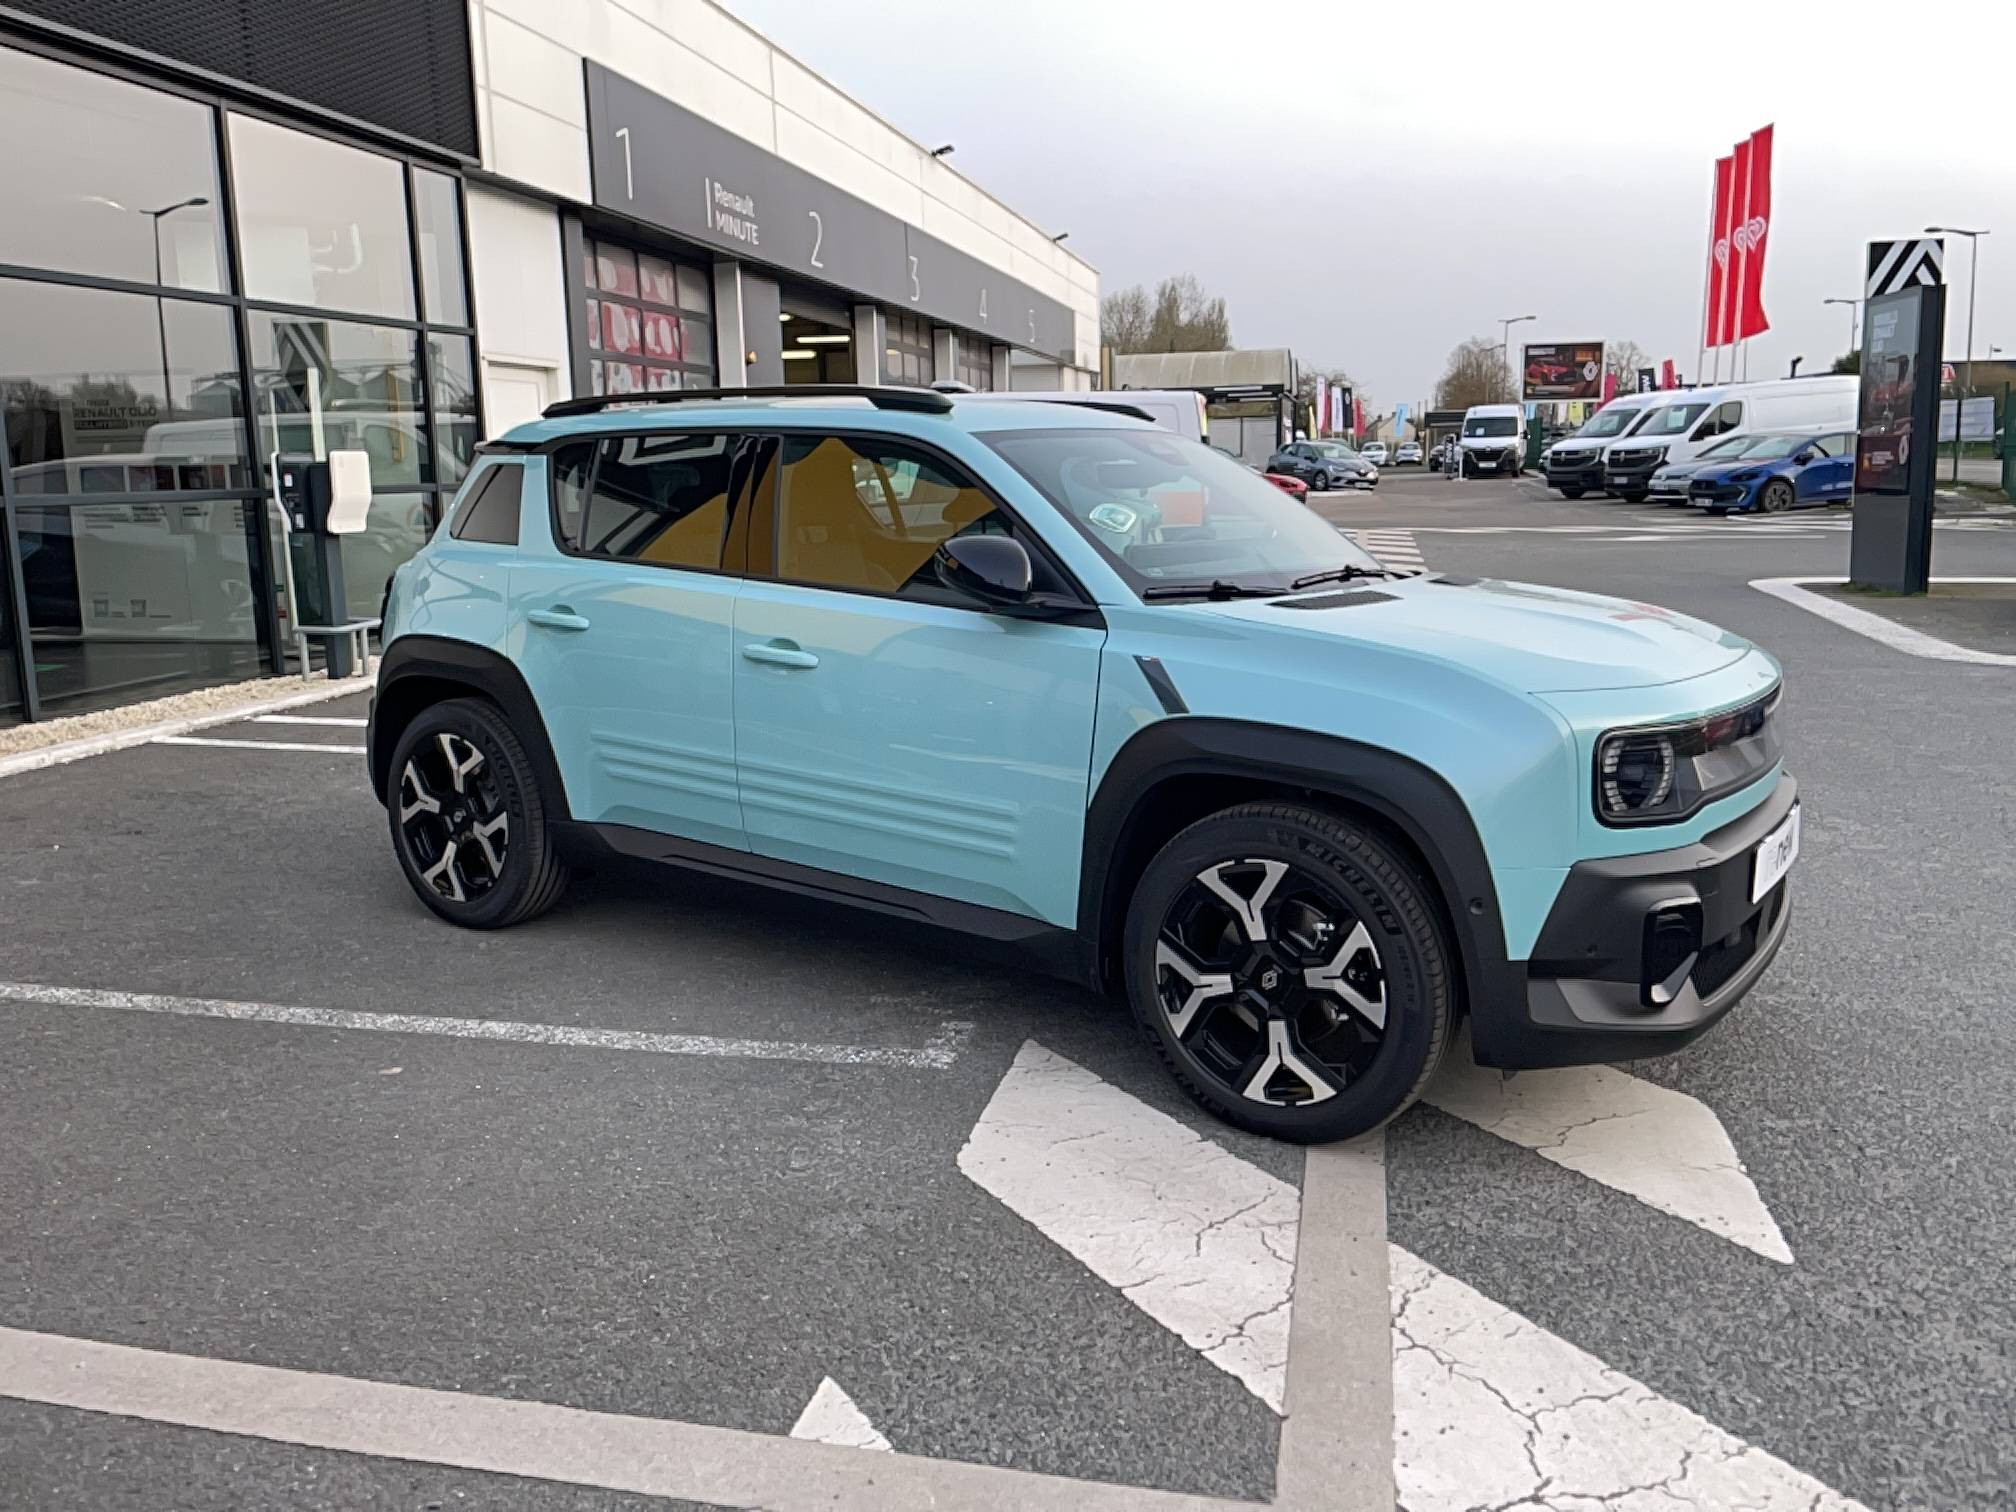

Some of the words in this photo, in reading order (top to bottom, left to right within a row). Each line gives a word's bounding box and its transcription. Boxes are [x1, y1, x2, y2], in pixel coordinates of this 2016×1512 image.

[616, 127, 634, 200] 1
[713, 181, 755, 219] Renault
[715, 209, 760, 245] MINUTE
[808, 210, 824, 269] 2
[908, 255, 921, 302] 3
[978, 288, 988, 324] 4
[1028, 309, 1036, 343] 5
